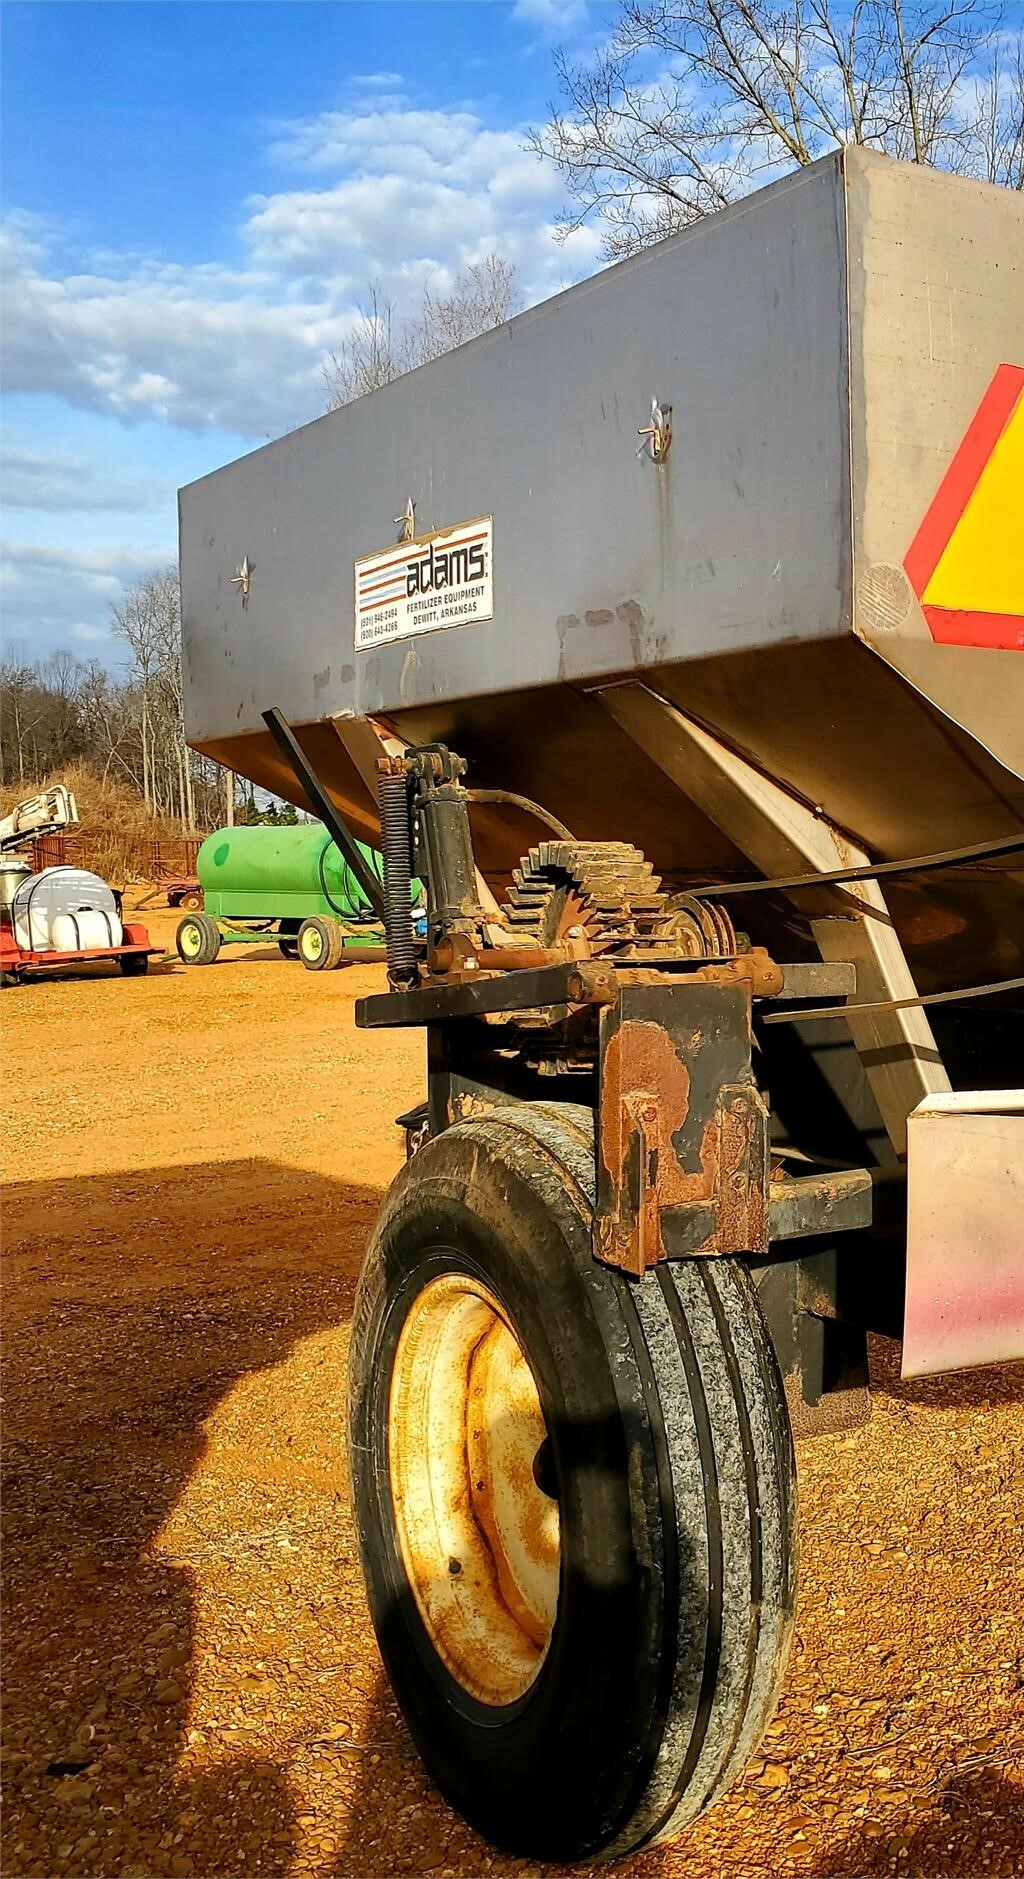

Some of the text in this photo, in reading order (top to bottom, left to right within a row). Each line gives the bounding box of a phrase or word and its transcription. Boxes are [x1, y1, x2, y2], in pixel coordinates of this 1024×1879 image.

[406, 542, 485, 598] adams
[406, 585, 485, 614] FERTILIZER EQUIPMENT
[413, 601, 478, 626] DEWITT, ARKANSAS
